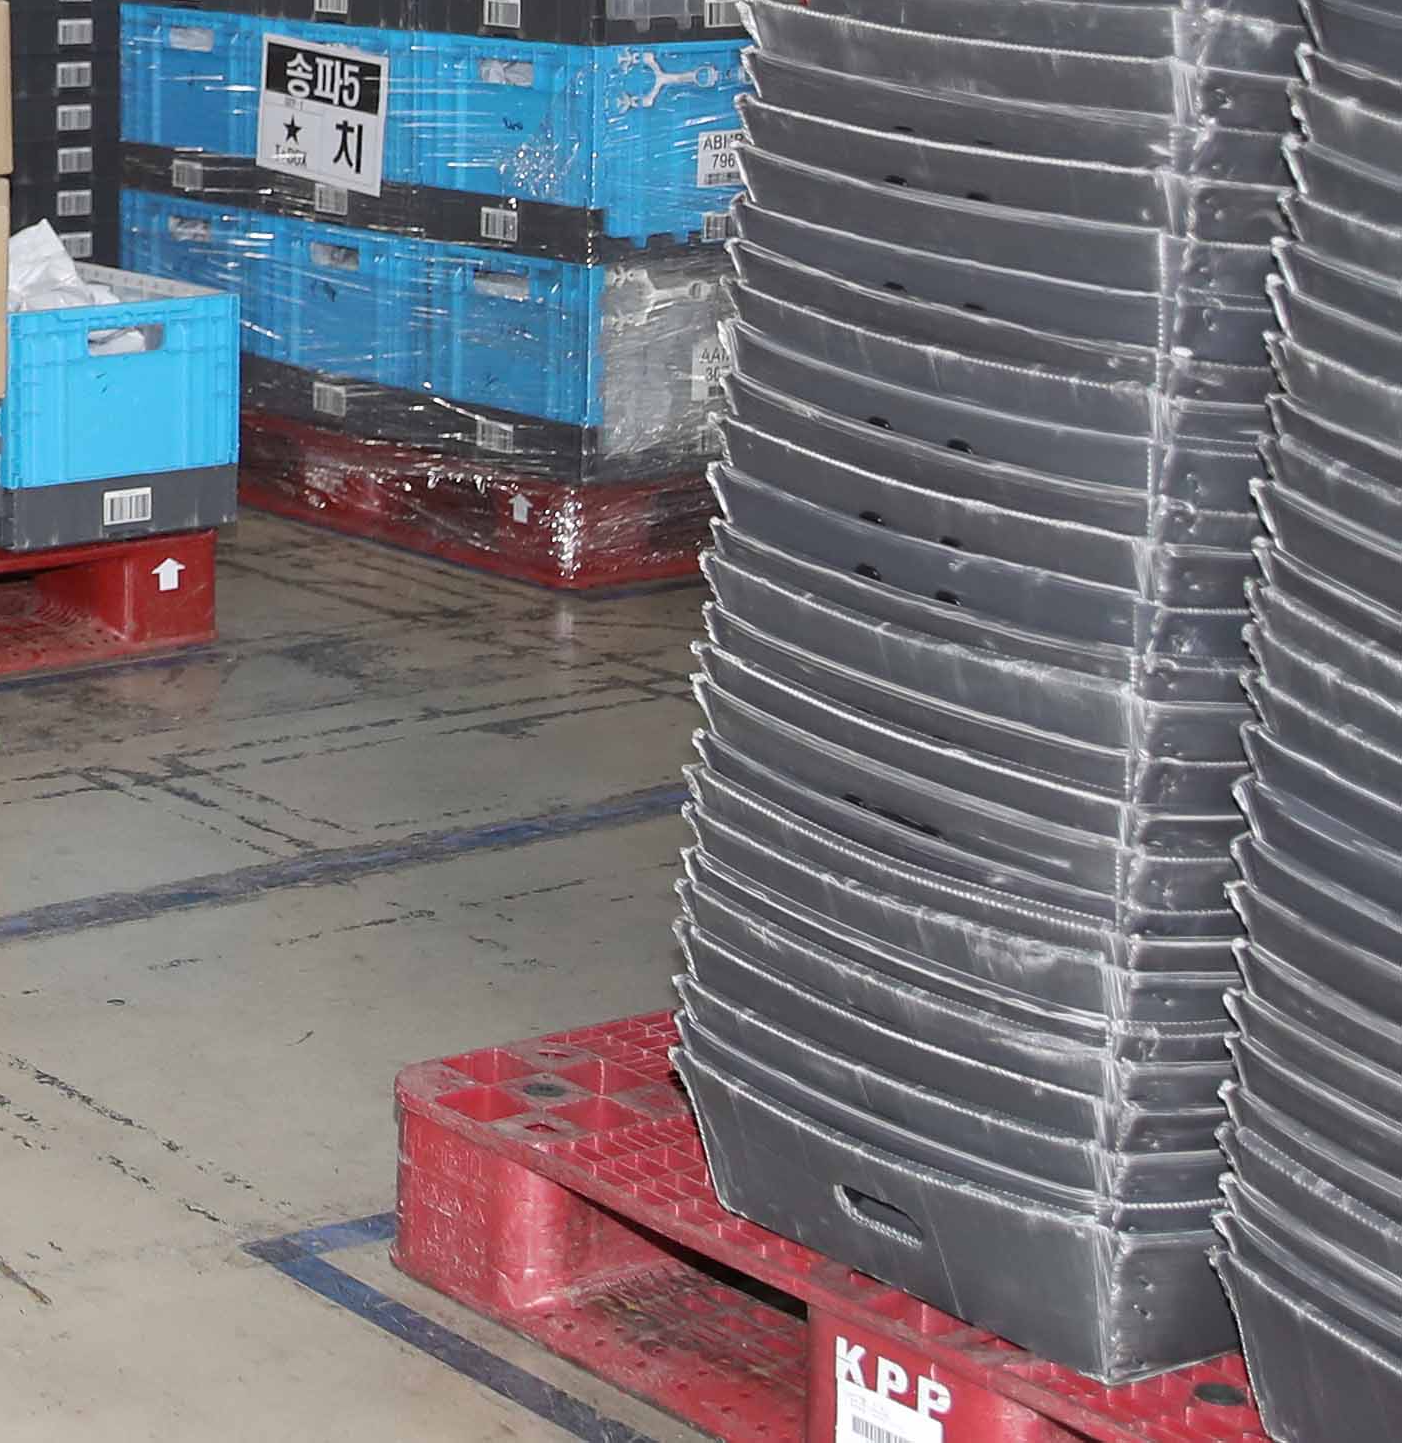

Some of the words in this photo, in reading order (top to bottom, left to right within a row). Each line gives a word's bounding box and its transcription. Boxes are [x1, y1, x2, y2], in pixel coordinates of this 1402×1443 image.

[286, 52, 360, 107] 송파5
[333, 120, 363, 174] 치
[712, 153, 735, 169] 796
[836, 1336, 952, 1415] KPP
